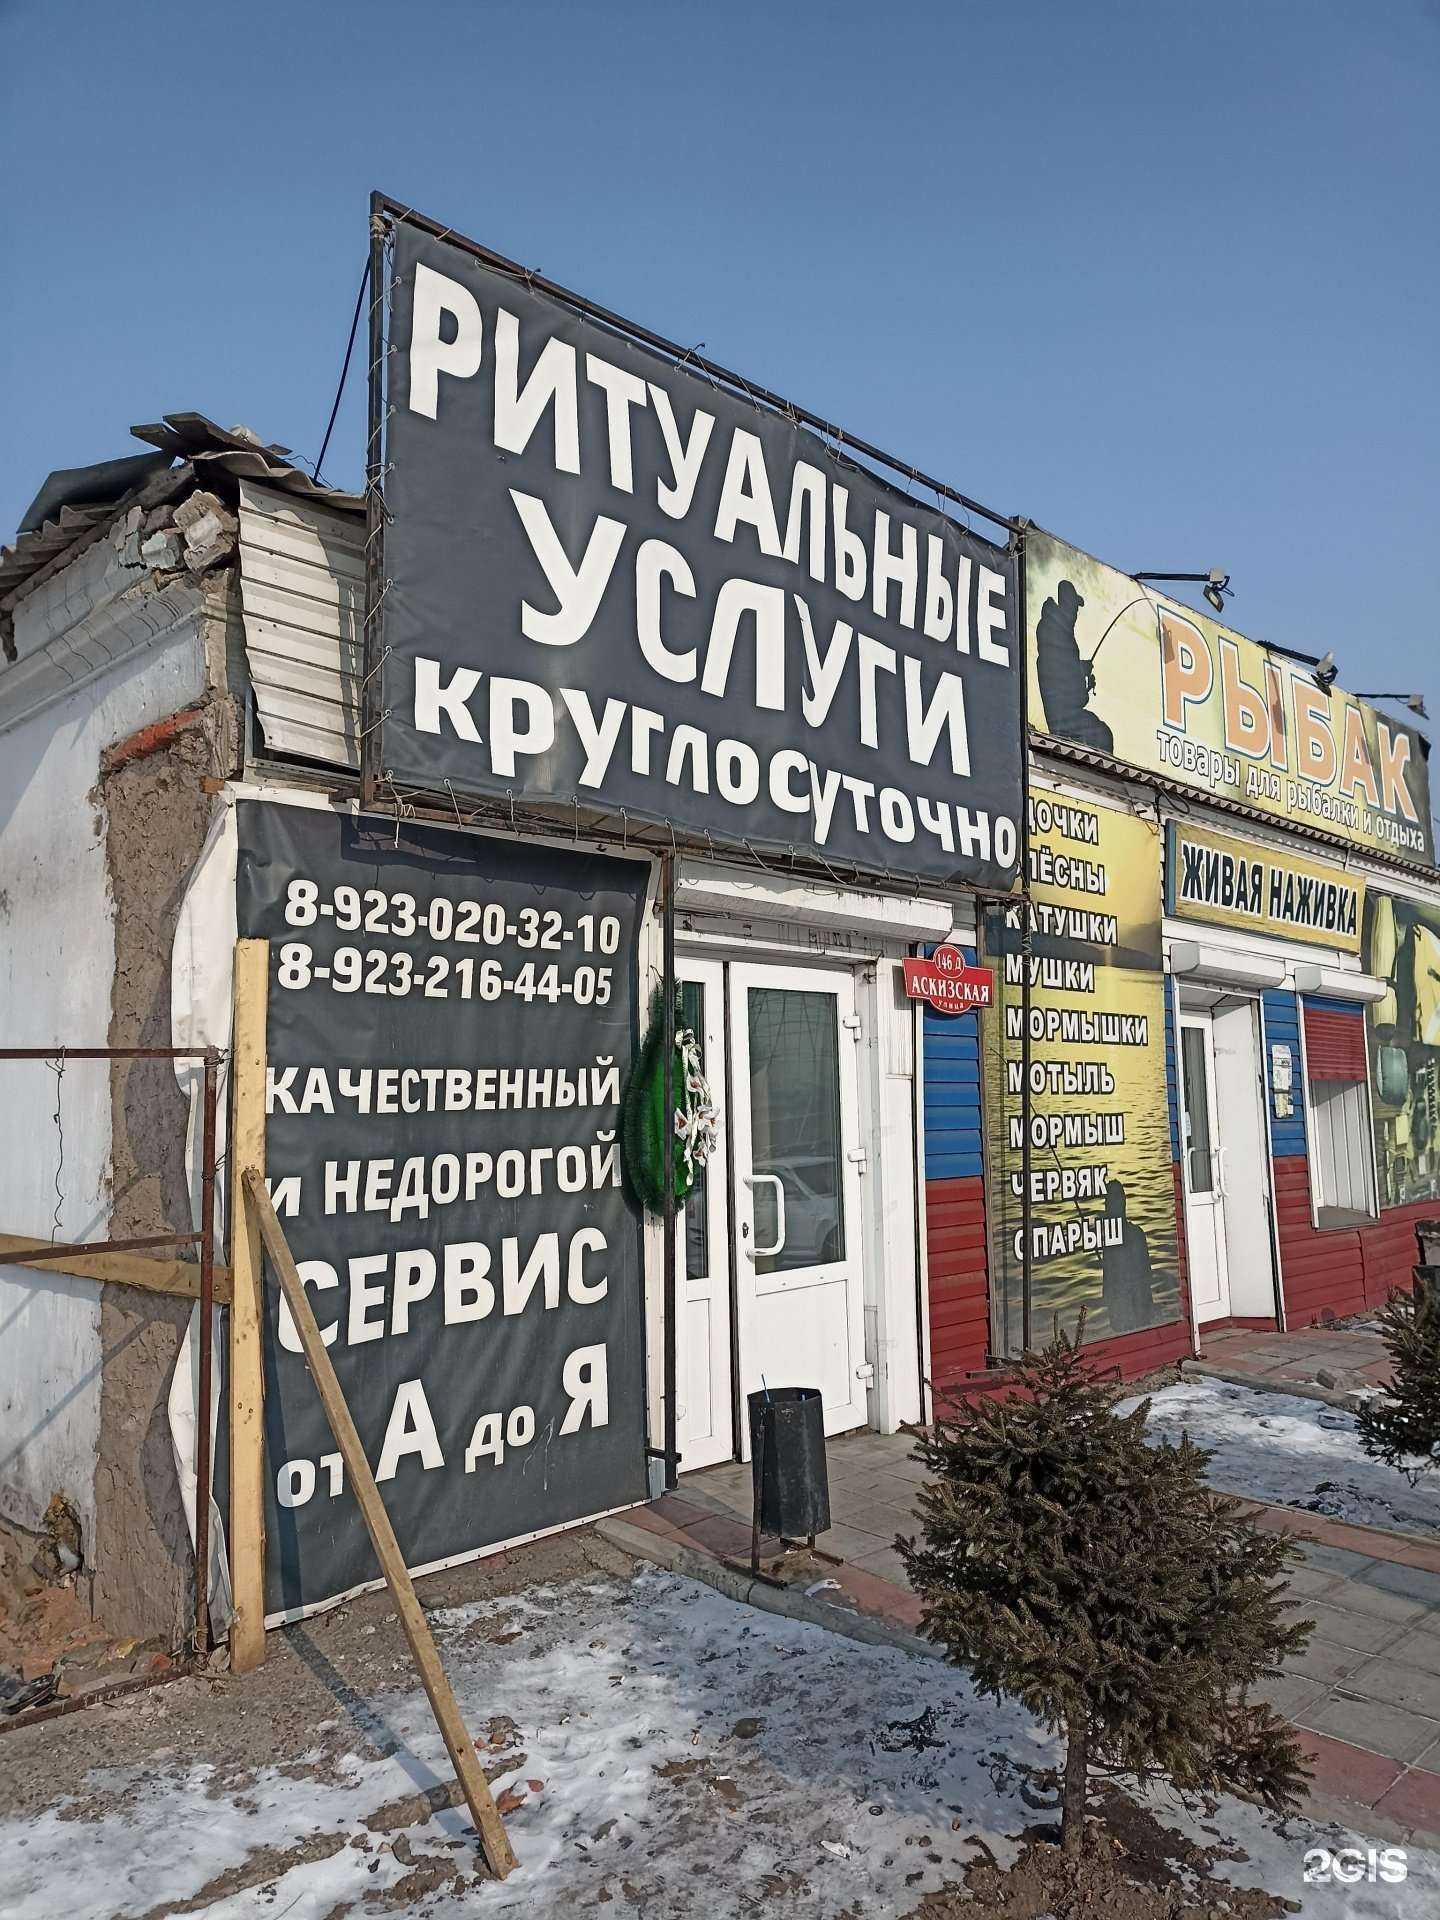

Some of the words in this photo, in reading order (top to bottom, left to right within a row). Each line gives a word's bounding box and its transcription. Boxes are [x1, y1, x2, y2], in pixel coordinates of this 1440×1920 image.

[409, 262, 1010, 668] РИТУАЛЬНЫЕ
[508, 488, 972, 778] УСЛУГИ
[1157, 604, 1419, 823] РЫБАК
[1157, 730, 1241, 788] товары
[1245, 764, 1281, 802] для
[1286, 780, 1361, 832] рыбалки
[1376, 818, 1426, 853] отдыха
[284, 879, 620, 956] 8-923-020-32-10
[1181, 841, 1264, 916] ЖИВАЯ
[1269, 867, 1358, 938] НАЖИВКА
[277, 943, 614, 1006] 8-923-216-44-05
[912, 975, 989, 1003] АСКИЗСКАЯ
[936, 953, 953, 972] 146
[1005, 953, 1095, 993] МУШКИ
[1006, 1005, 1149, 1046] МОРМЫШКИ
[265, 1055, 621, 1114] КАЧЕСТВЕННЫЙ
[1008, 1060, 1115, 1095] МОТЫЛЬ
[1009, 1112, 1125, 1150] МОРМЫШ
[324, 1130, 622, 1223] НЕДОРОГОЙ
[1011, 1164, 1108, 1203] ЧЕРВЯК
[278, 1227, 609, 1353] СЕРВИС
[375, 1378, 445, 1483] А
[559, 1343, 609, 1436] Я
